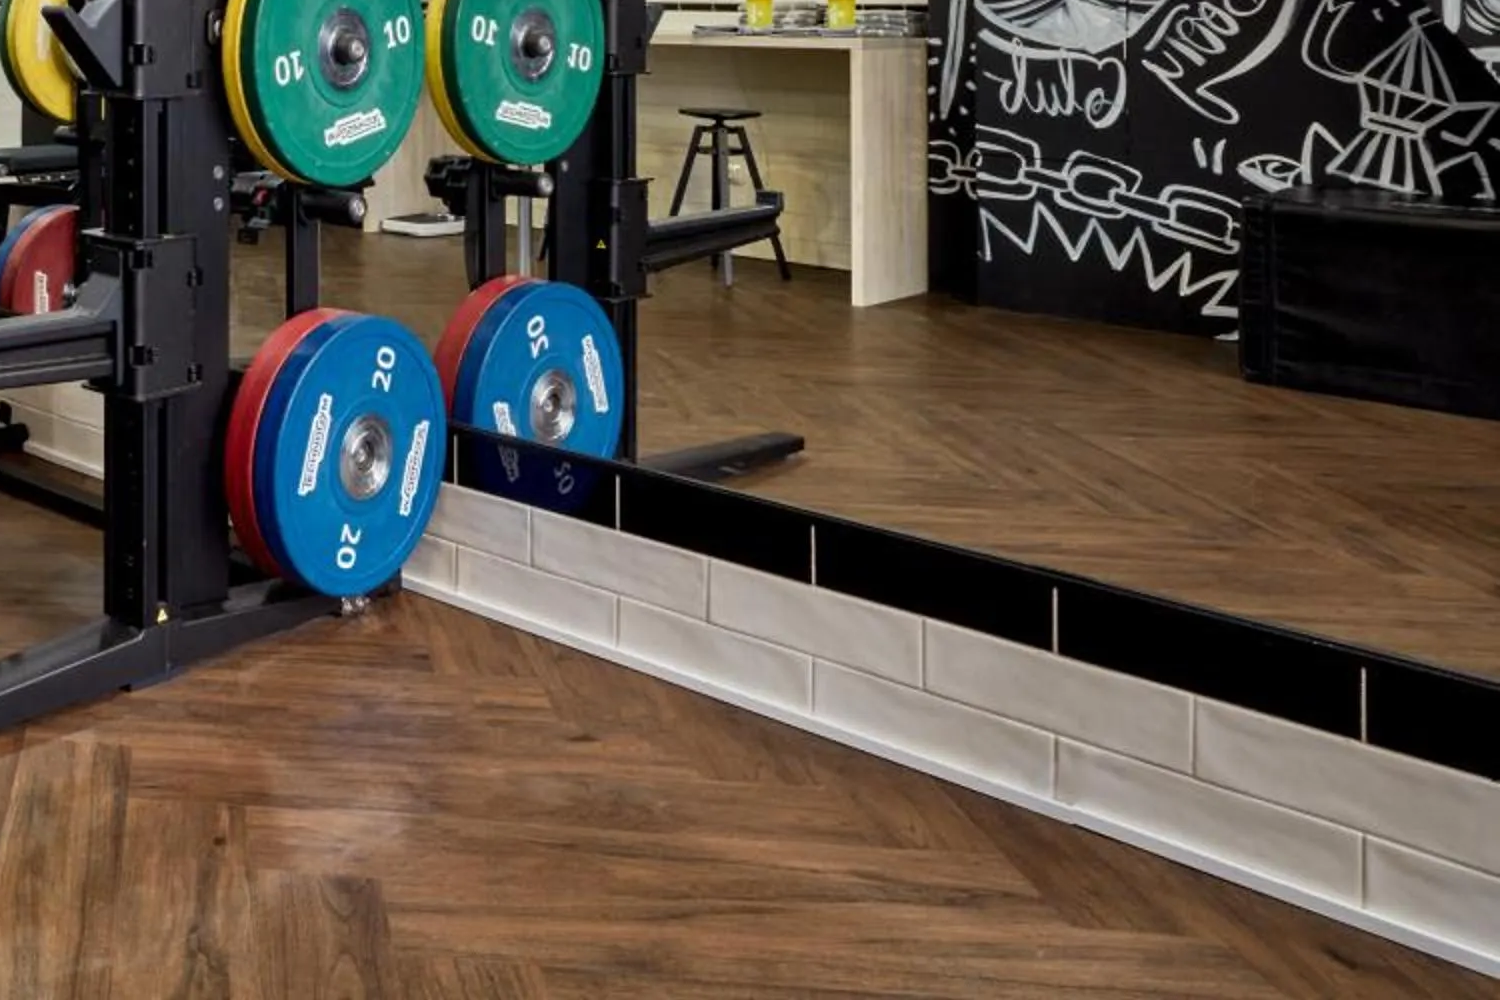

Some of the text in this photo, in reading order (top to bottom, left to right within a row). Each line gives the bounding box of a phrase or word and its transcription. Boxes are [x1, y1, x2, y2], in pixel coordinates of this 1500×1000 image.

[383, 16, 411, 49] 10
[275, 50, 304, 86] 10
[372, 346, 395, 392] 20
[336, 523, 362, 570] 20
